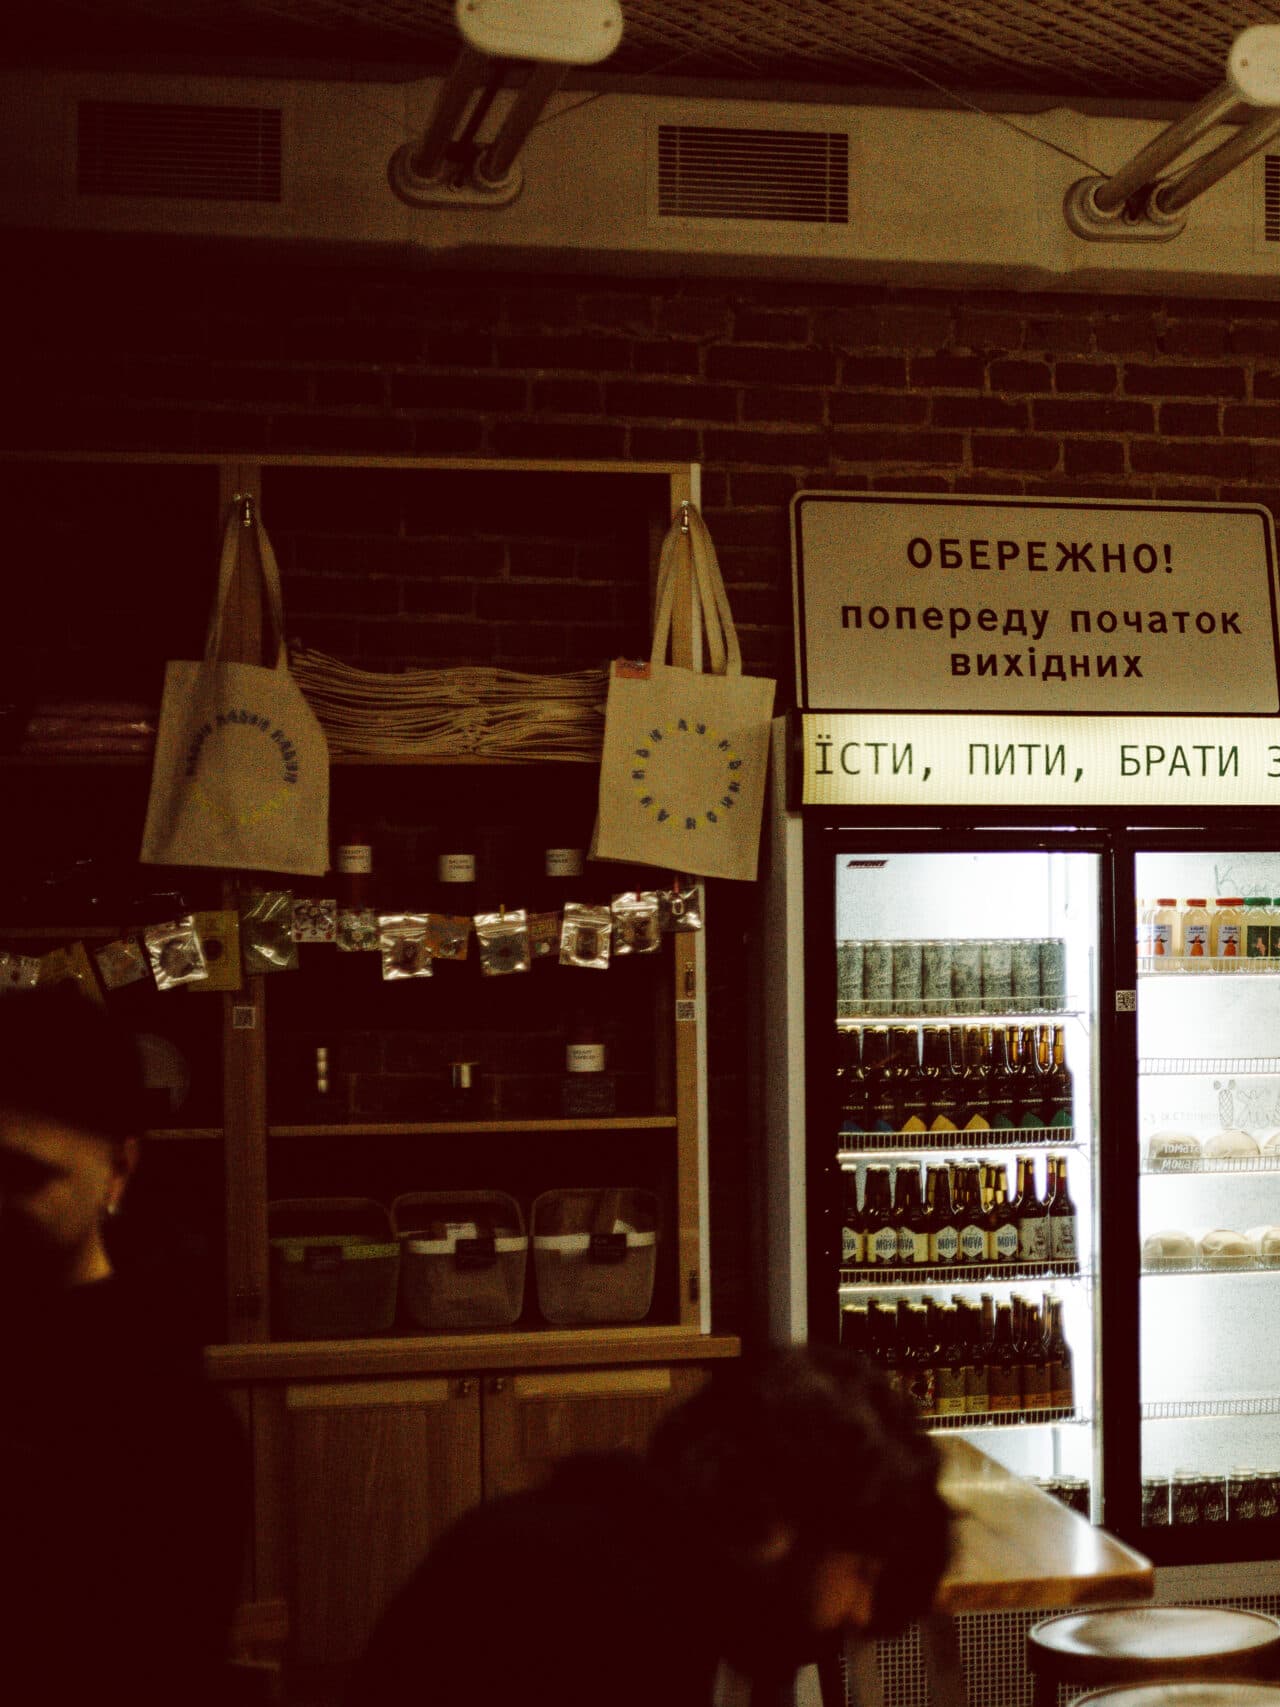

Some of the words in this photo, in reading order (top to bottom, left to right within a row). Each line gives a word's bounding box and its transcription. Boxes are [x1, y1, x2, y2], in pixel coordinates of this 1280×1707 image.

[906, 537, 1174, 575] ОБЕРЕЖНО!
[841, 604, 1049, 641] попереду
[1070, 608, 1242, 635] початок
[950, 646, 1143, 682] вихідних
[813, 733, 932, 783] ЇСТИ,
[968, 743, 1085, 784] ПИТИ,
[1120, 743, 1240, 778] БРАТИ
